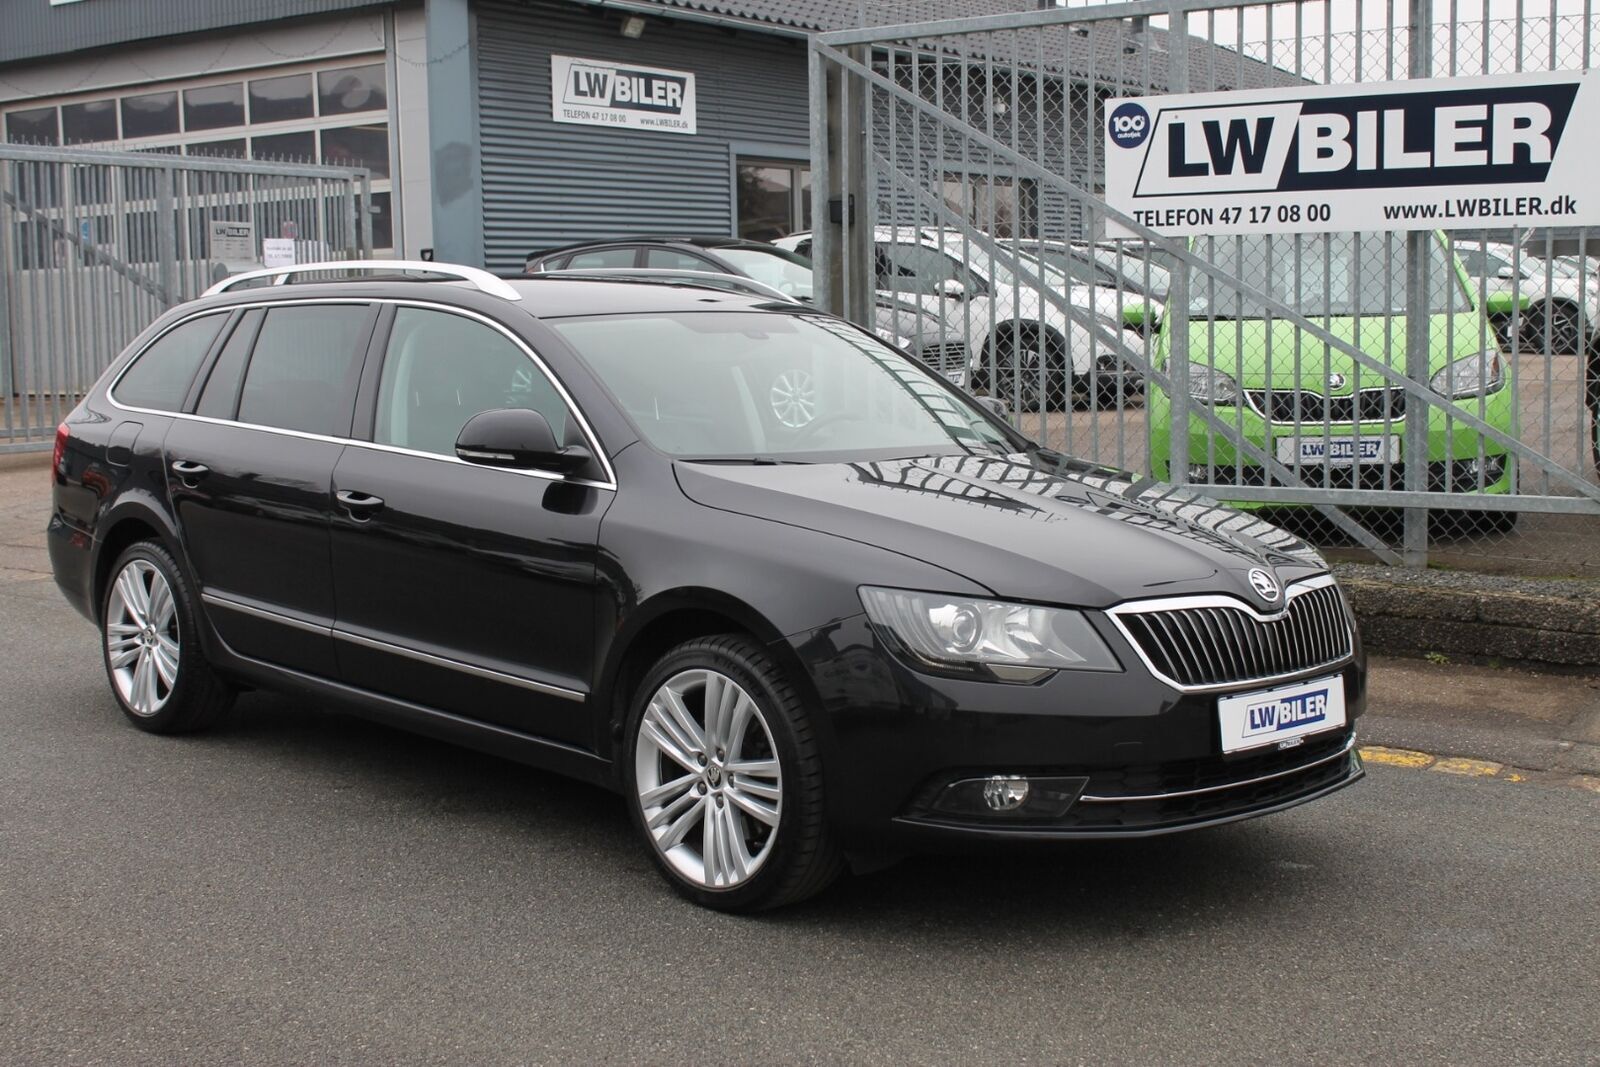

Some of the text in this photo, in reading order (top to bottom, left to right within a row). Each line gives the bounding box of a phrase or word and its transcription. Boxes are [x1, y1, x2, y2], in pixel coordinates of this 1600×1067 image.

[563, 109, 688, 129] TELEFON 47 17 08 00 www.LWBILER.dk
[1133, 194, 1577, 227] TELEFON 47 17 08 00 www.LWBILER.dk
